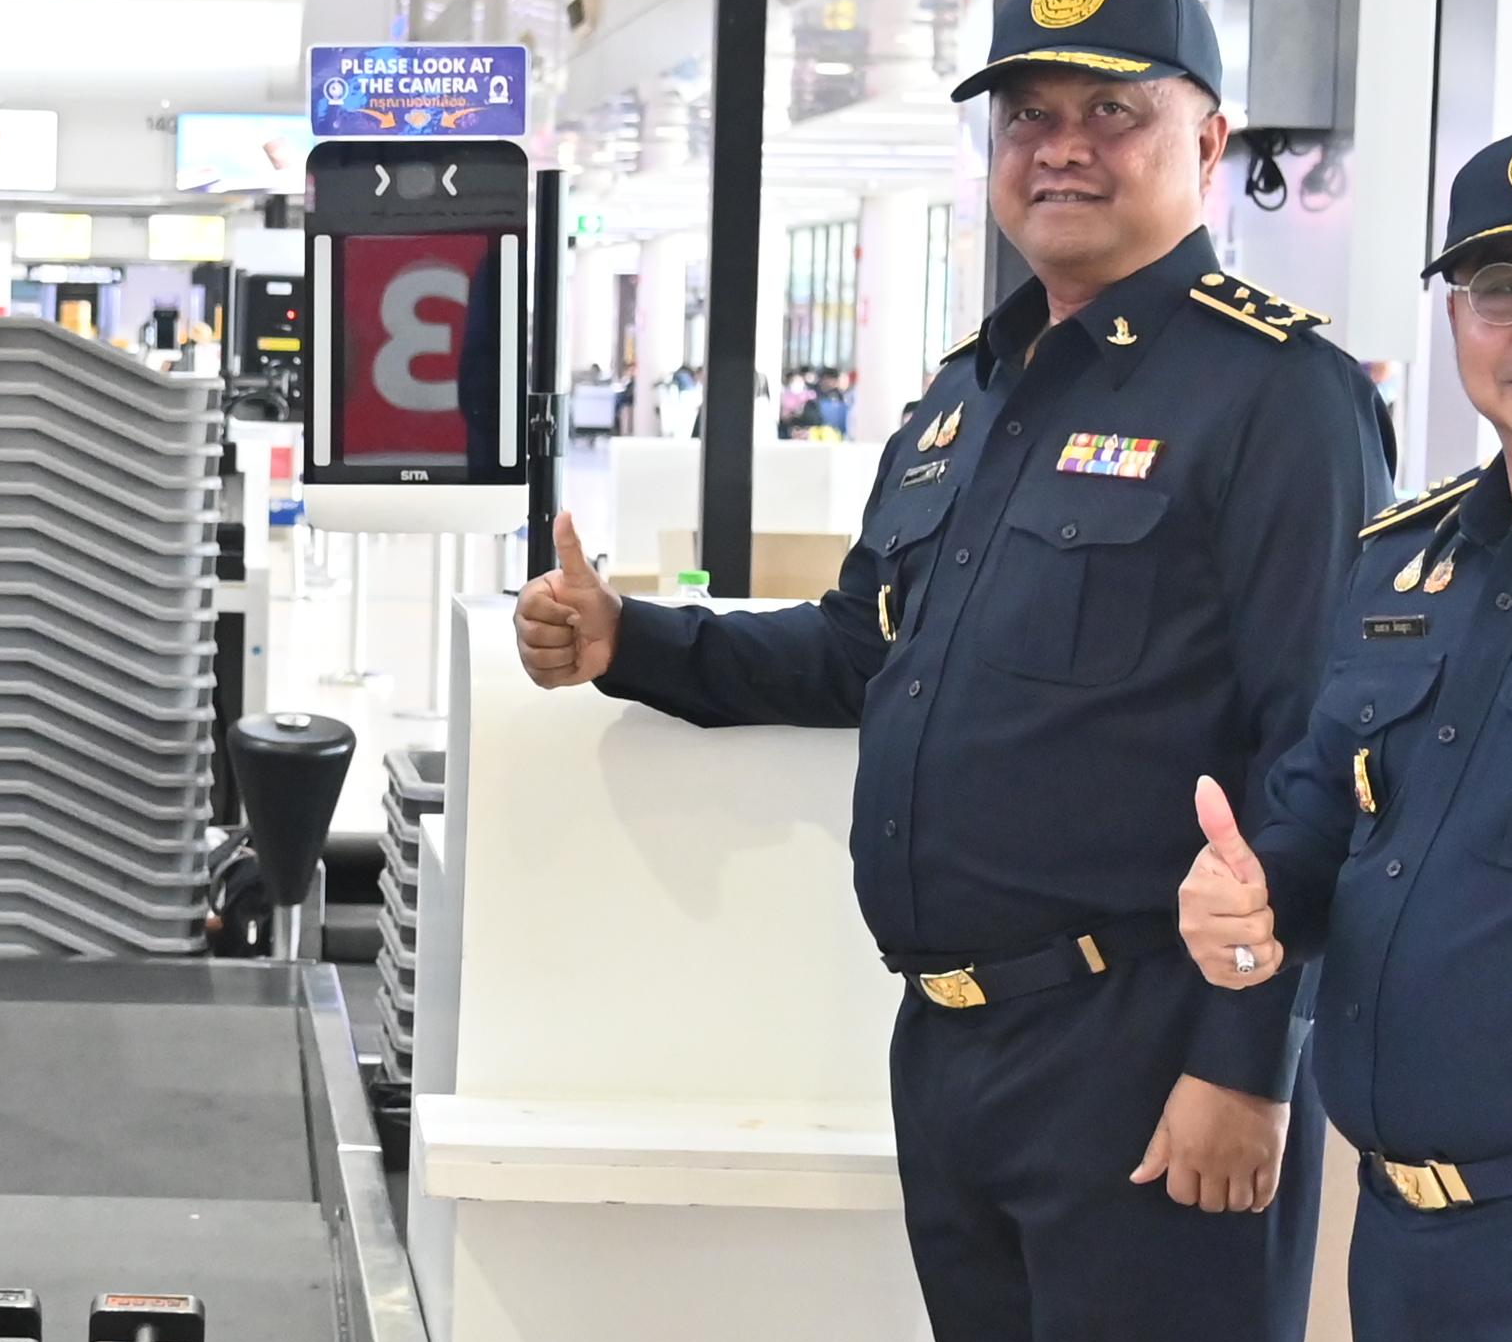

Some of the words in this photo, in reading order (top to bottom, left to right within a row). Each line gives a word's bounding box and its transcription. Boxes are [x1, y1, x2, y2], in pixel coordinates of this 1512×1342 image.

[341, 58, 408, 74] PLEASE
[413, 58, 466, 74] LOOK
[470, 57, 494, 73] AT
[358, 77, 394, 93] THE
[398, 77, 478, 93] CAMERA
[400, 470, 429, 481] SITA
